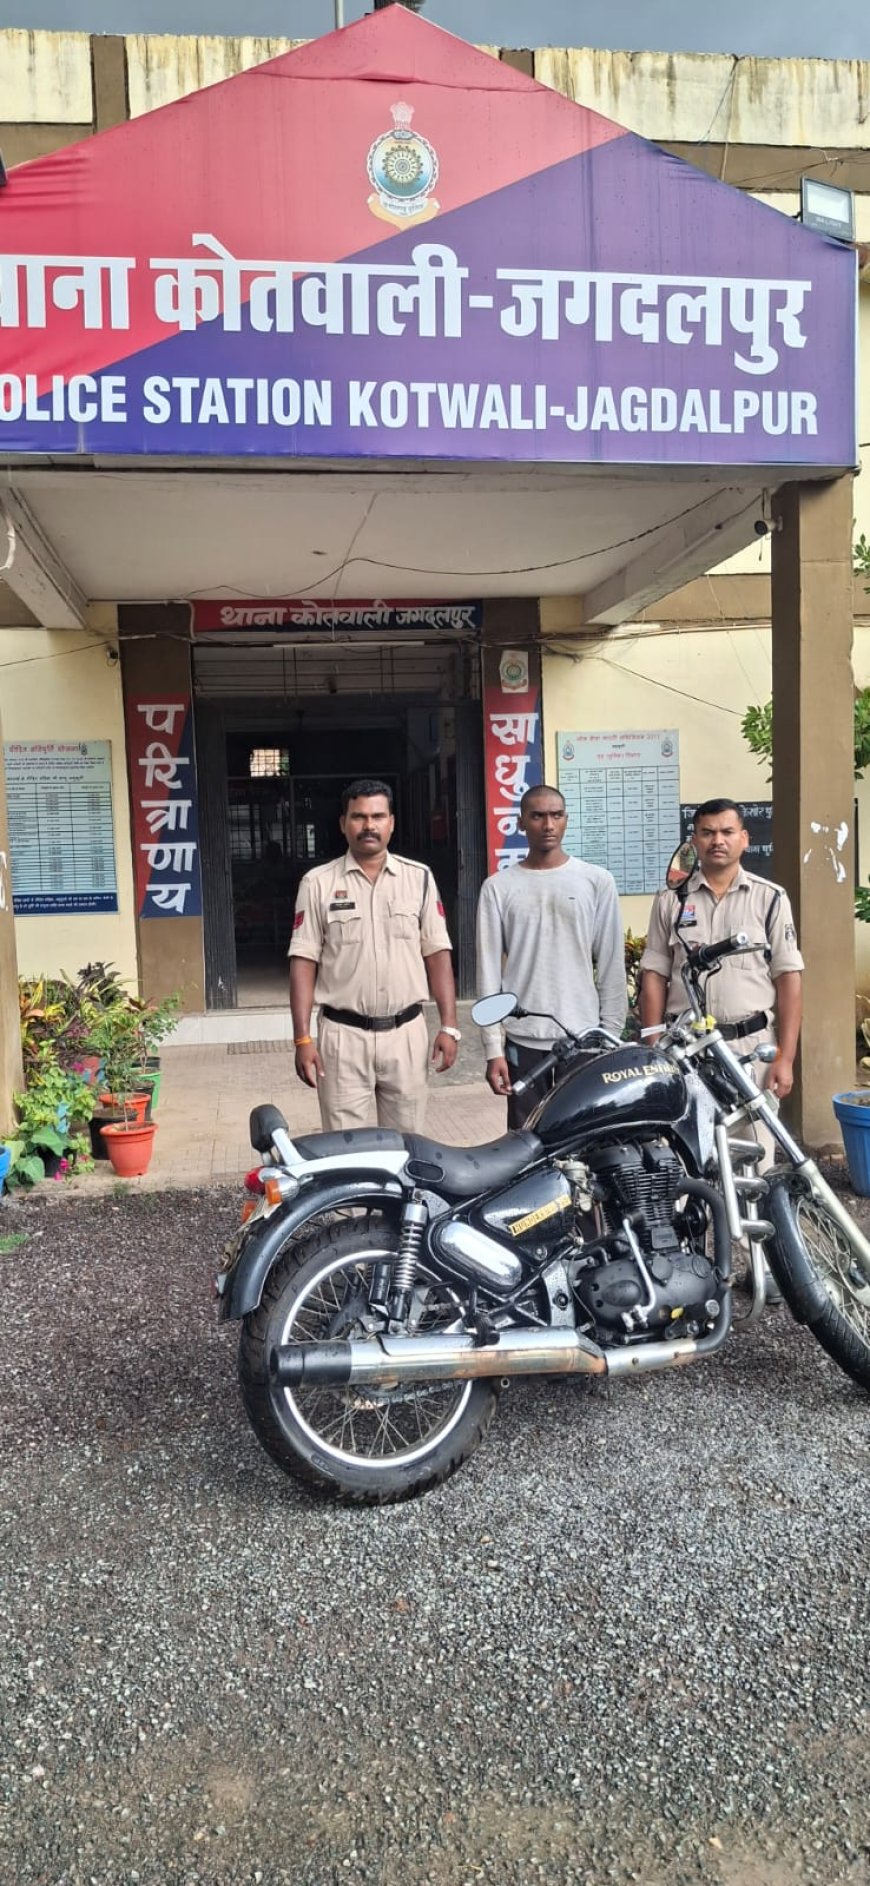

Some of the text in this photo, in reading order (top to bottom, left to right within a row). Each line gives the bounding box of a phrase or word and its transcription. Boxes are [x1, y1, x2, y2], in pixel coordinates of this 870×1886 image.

[149, 233, 812, 375] कोतवाली-जगदलपुर
[0, 374, 818, 435] OLICE STATION KOTWALI-JAGDALPUR
[220, 600, 476, 629] थाना कोतवाली जगदलपुर
[601, 1066, 642, 1084] ROYAL
